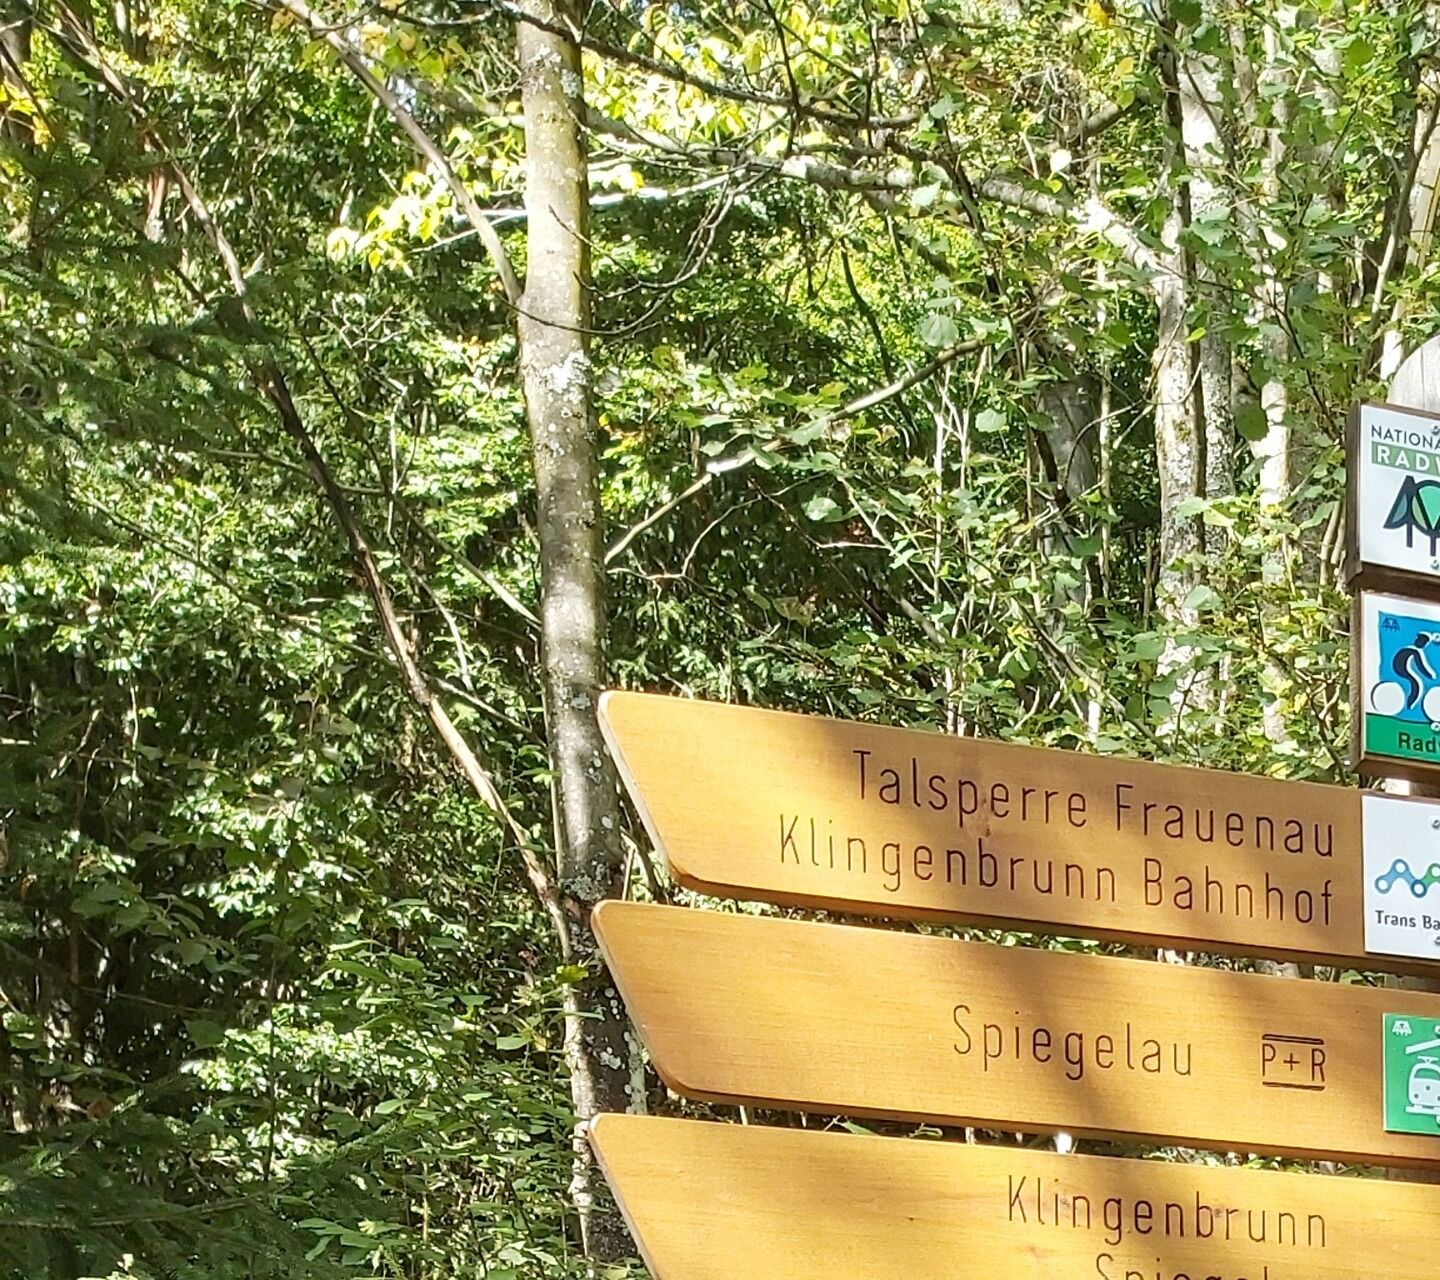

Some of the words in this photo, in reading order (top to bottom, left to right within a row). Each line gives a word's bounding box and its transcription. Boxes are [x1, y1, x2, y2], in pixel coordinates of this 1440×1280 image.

[852, 749, 1088, 829] Talsperre
[1115, 783, 1334, 858] Frauenau
[778, 813, 1117, 903] Klingenbrunn
[1144, 857, 1333, 926] Bahnhof
[1375, 909, 1416, 928] Trans
[953, 1004, 1192, 1081] Spiegelau
[1262, 1043, 1327, 1083] P+R
[1008, 1174, 1326, 1247] Klingenbrunn
